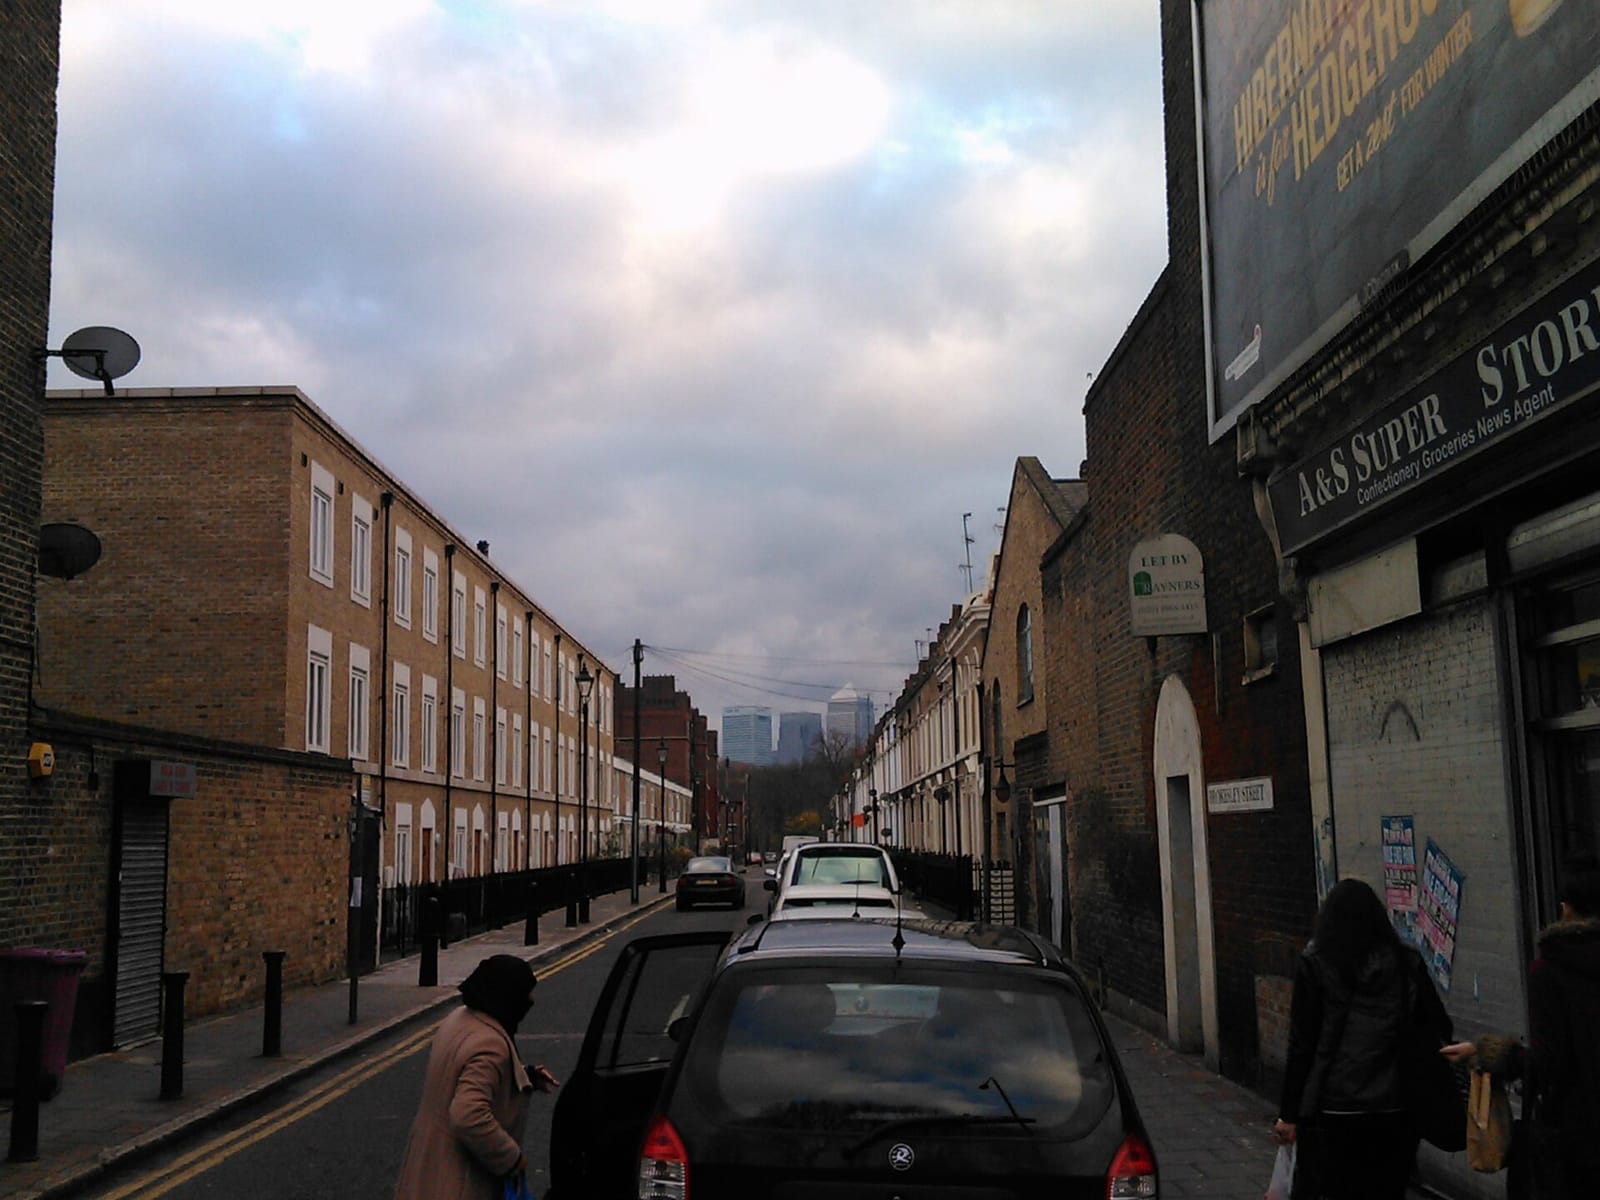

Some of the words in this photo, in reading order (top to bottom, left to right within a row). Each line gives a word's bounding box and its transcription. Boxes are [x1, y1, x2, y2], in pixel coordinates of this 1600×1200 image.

[1337, 146, 1354, 192] GET
[1355, 140, 1364, 173] A
[1401, 67, 1425, 118] FOR
[1424, 9, 1473, 89] WINTER
[1299, 446, 1349, 517] A&S
[1351, 393, 1448, 482] SUPER
[1356, 458, 1420, 505] Confectionery
[1422, 427, 1476, 469] Groceries
[1476, 406, 1512, 438] News
[1513, 381, 1556, 422] Agent
[1141, 556, 1167, 567] LET
[1171, 554, 1188, 565] BY
